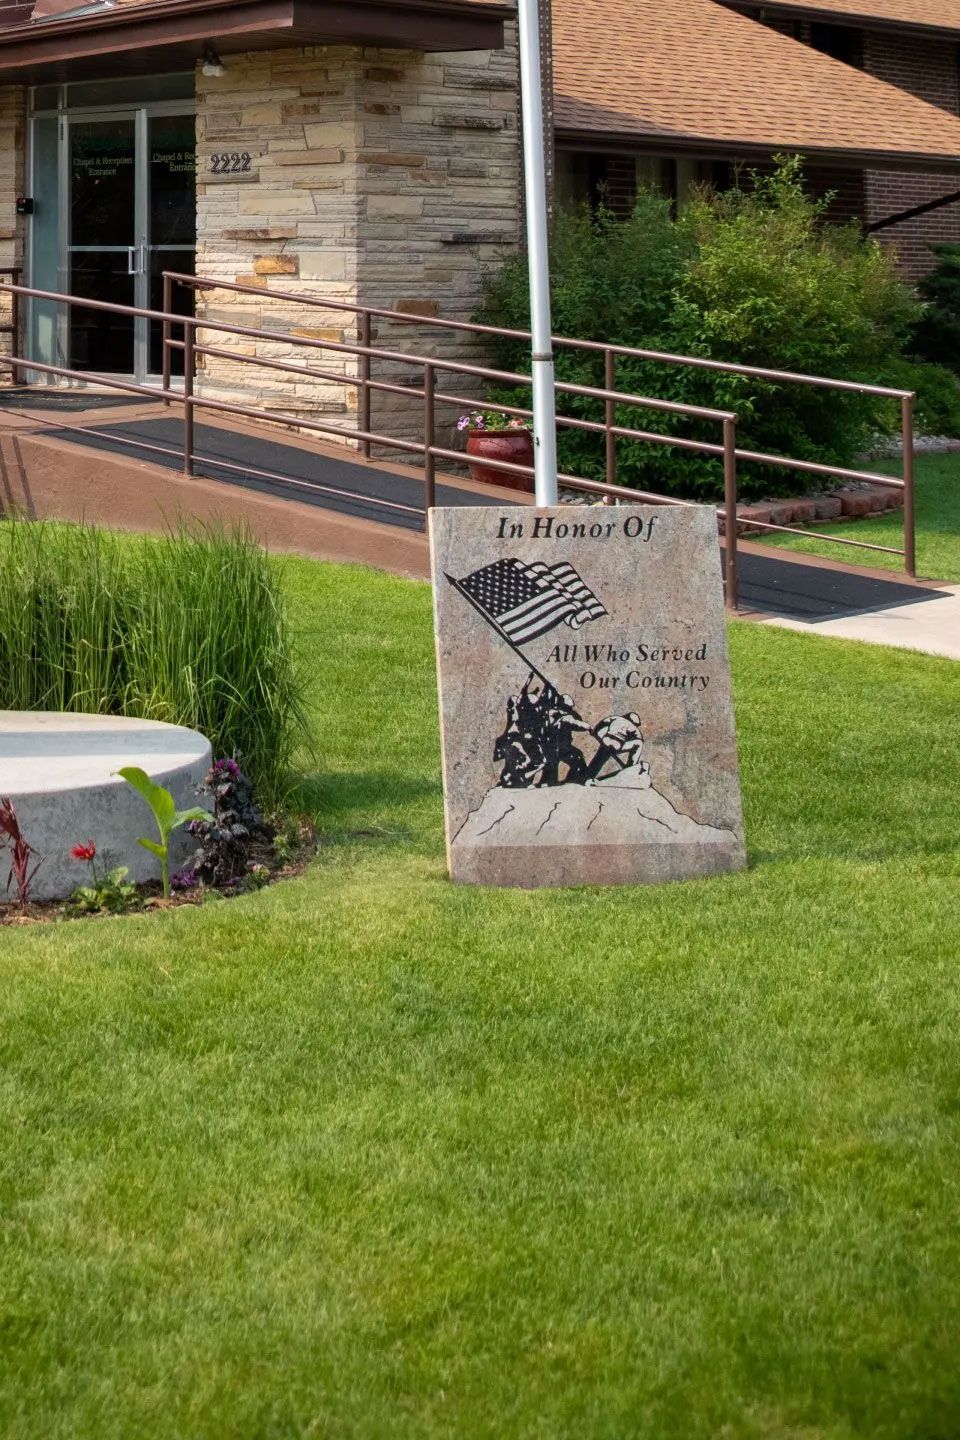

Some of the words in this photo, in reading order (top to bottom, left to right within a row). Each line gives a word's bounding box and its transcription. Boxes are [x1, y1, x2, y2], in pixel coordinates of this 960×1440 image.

[152, 152, 176, 162] Chapel
[210, 152, 251, 174] 2222
[496, 517, 524, 539] In
[530, 516, 616, 539] Honor
[623, 515, 658, 542] Of
[546, 644, 577, 663] All
[584, 644, 631, 662] Who
[636, 643, 707, 662] Served
[579, 671, 620, 689] Our
[625, 670, 710, 692] Country
